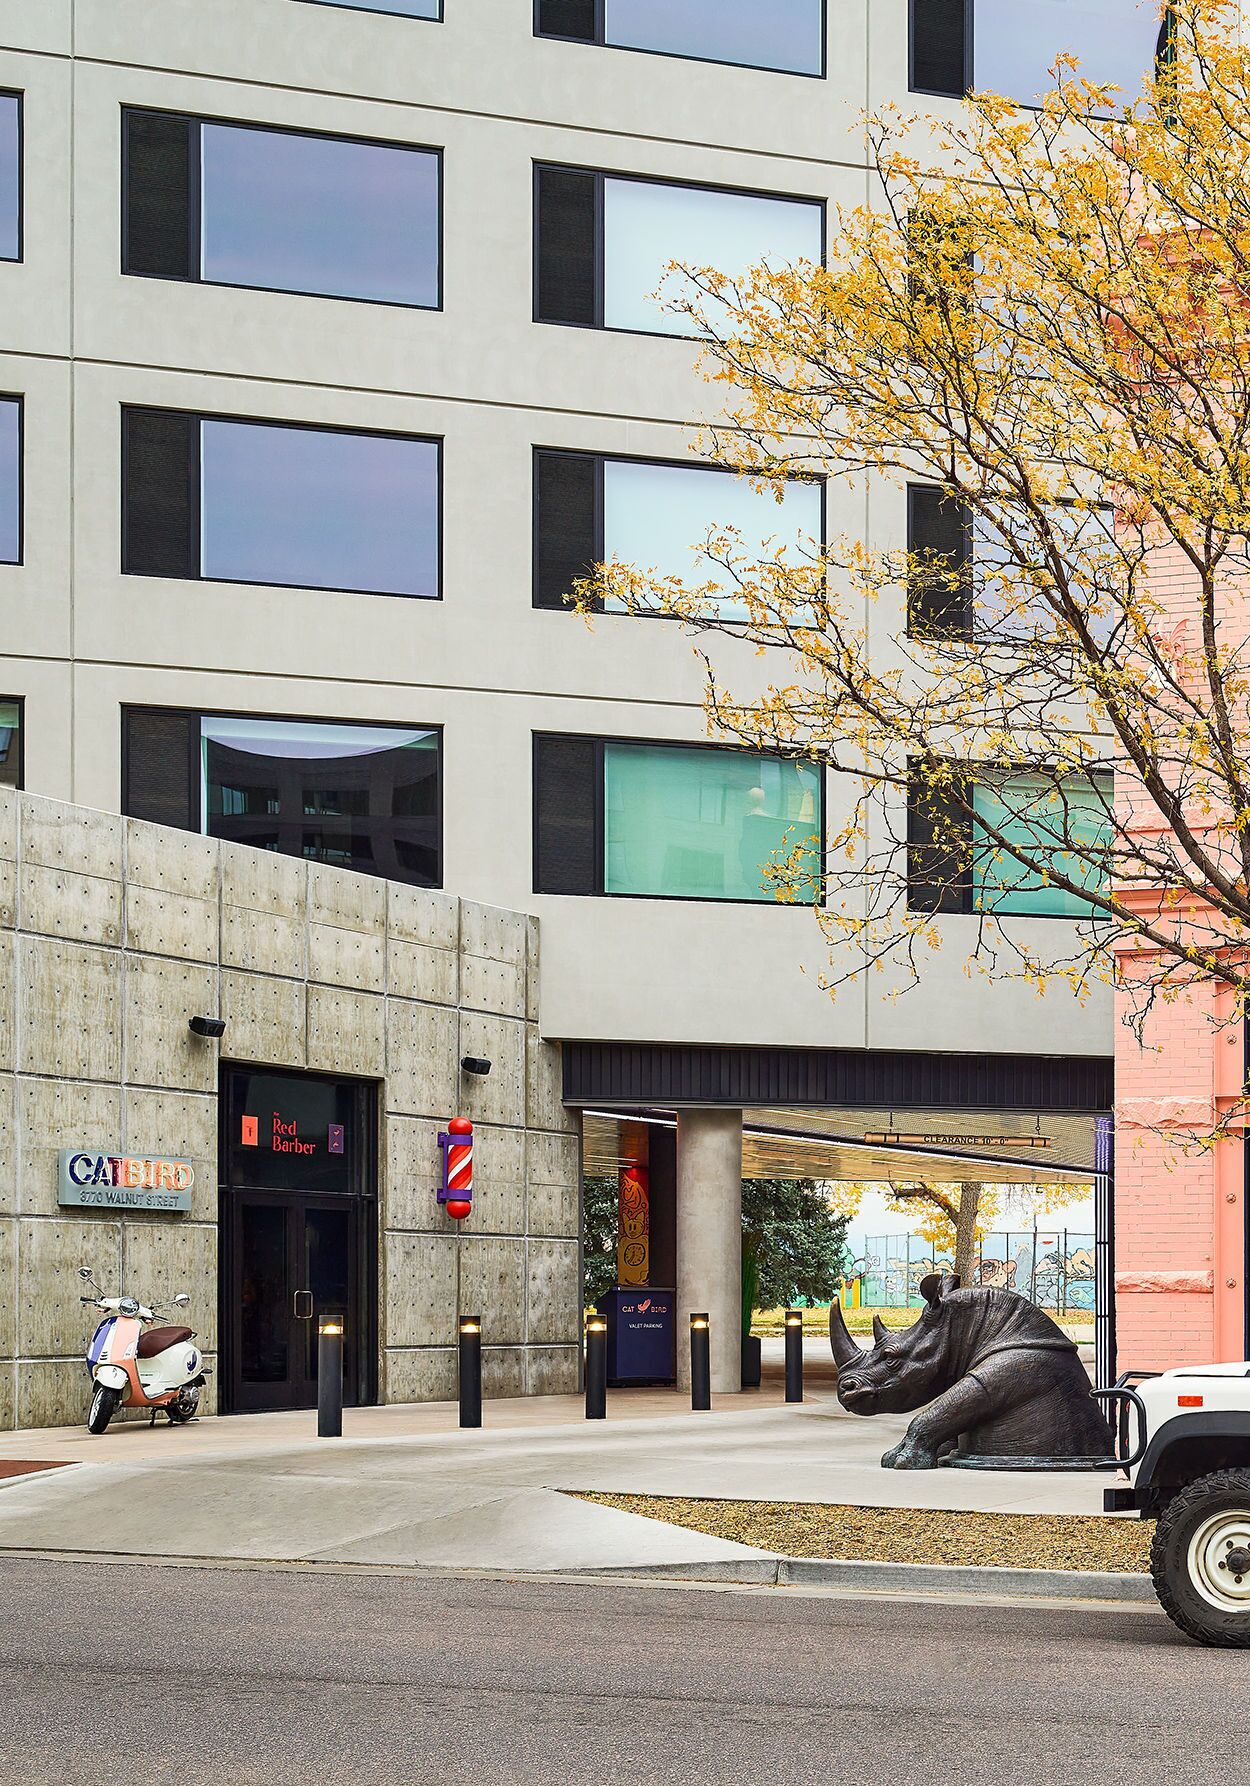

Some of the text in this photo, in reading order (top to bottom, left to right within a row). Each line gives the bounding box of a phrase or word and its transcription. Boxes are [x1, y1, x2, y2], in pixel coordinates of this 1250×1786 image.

[273, 1118, 297, 1135] Red
[272, 1135, 315, 1154] Barber
[924, 1135, 979, 1145] CLEARANCE
[69, 1153, 195, 1190] CATBIRD
[105, 1191, 144, 1205] WALNUT
[146, 1195, 179, 1207] STREET
[622, 1305, 635, 1313] CAT
